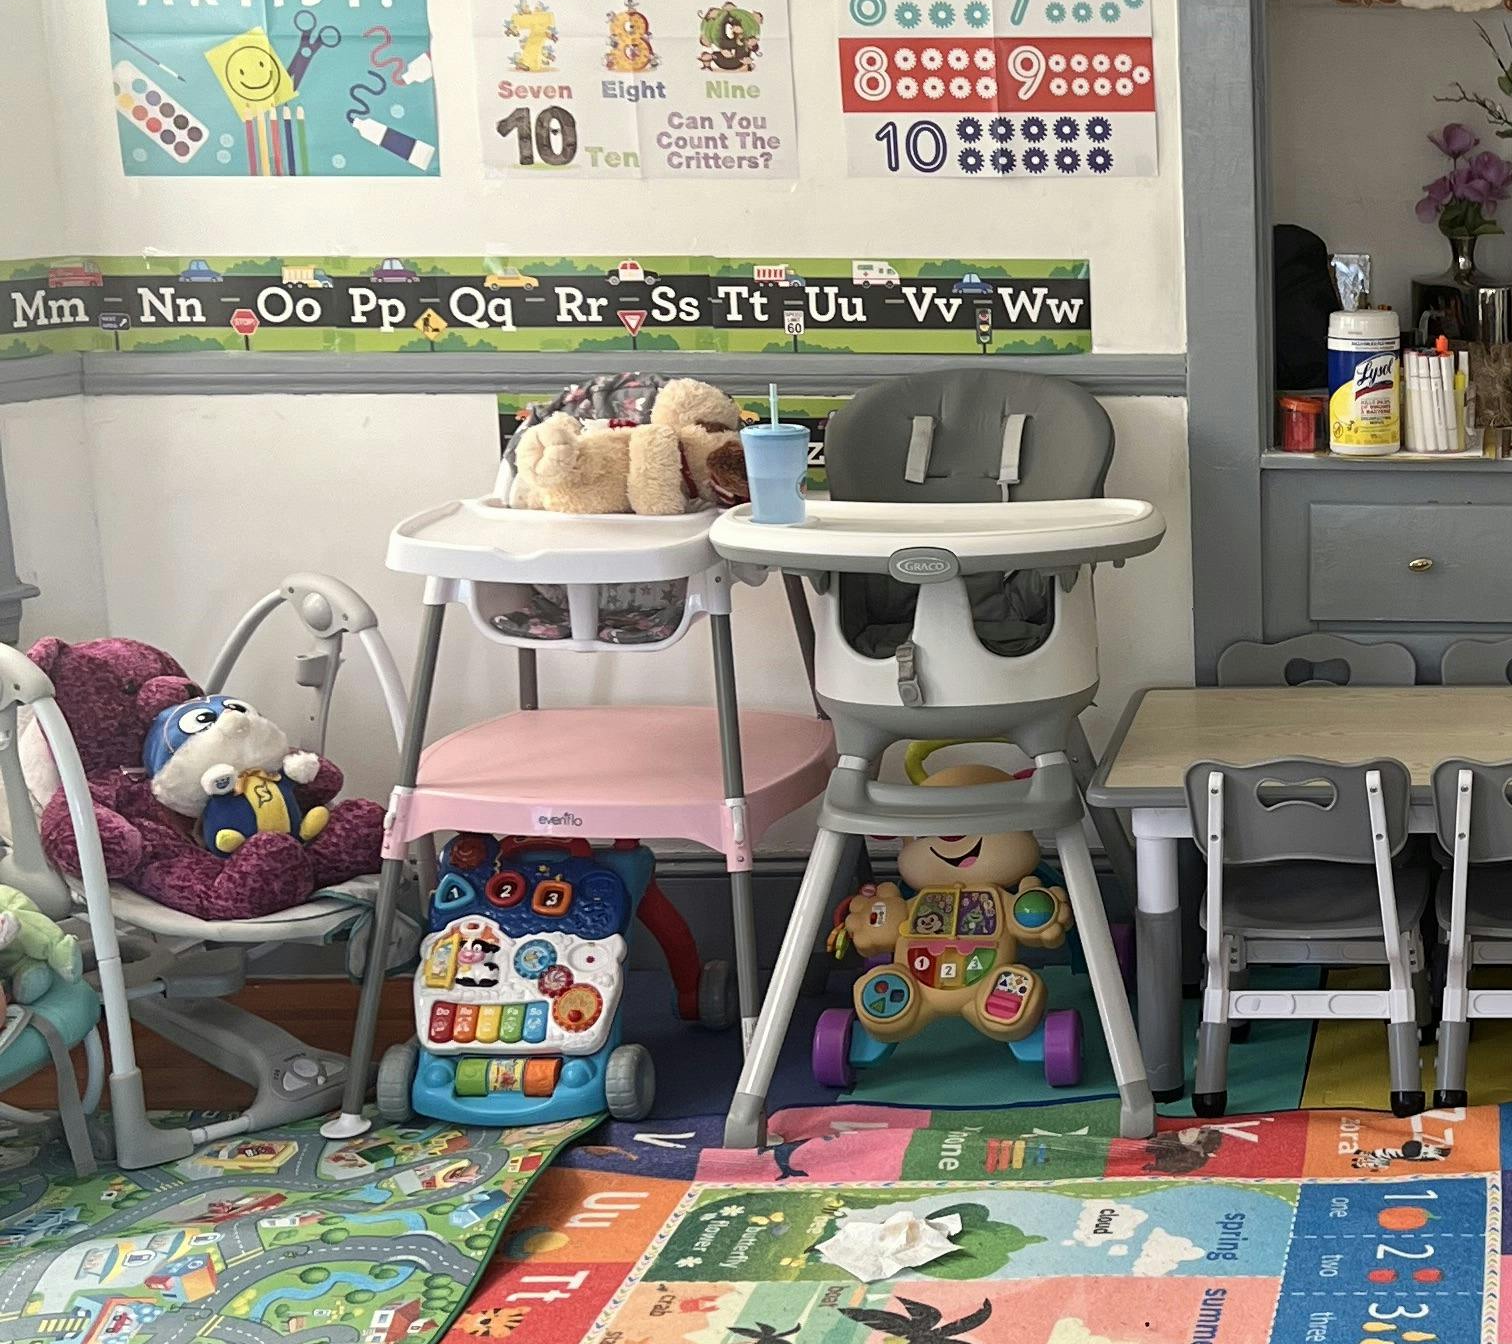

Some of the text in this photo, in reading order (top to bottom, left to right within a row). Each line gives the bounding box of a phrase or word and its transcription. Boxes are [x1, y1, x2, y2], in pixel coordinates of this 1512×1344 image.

[854, 46, 892, 101] 8
[1007, 45, 1047, 101] 9
[497, 81, 573, 100] Seven
[601, 80, 667, 101] Eight
[706, 80, 760, 99] Nine
[667, 112, 767, 130] Can You
[497, 105, 640, 168] 10 Ten
[656, 131, 780, 150] Count The
[875, 120, 948, 173] 10
[666, 151, 773, 170] Critters?
[12, 286, 1084, 333] Mm Nn Oo Pp Qq Rr Ss Tt Uu Vv Ww
[1357, 358, 1394, 386] Lysol
[904, 561, 945, 571] GRACO
[538, 812, 583, 826] evenflo
[450, 887, 459, 899] 1
[500, 884, 512, 898] 2
[545, 892, 558, 906] 3
[918, 958, 926, 970] 1
[944, 965, 953, 977] 2
[1383, 1189, 1439, 1201] 1
[564, 1191, 650, 1228] Uu
[1329, 1197, 1350, 1219] one
[1093, 1208, 1116, 1236] cloud
[1206, 1212, 1247, 1261] spring
[1376, 1243, 1435, 1261] 2
[1319, 1254, 1343, 1278] two
[505, 1270, 590, 1302] Tt
[1367, 1302, 1429, 1321] 3
[1305, 1311, 1334, 1344] three
